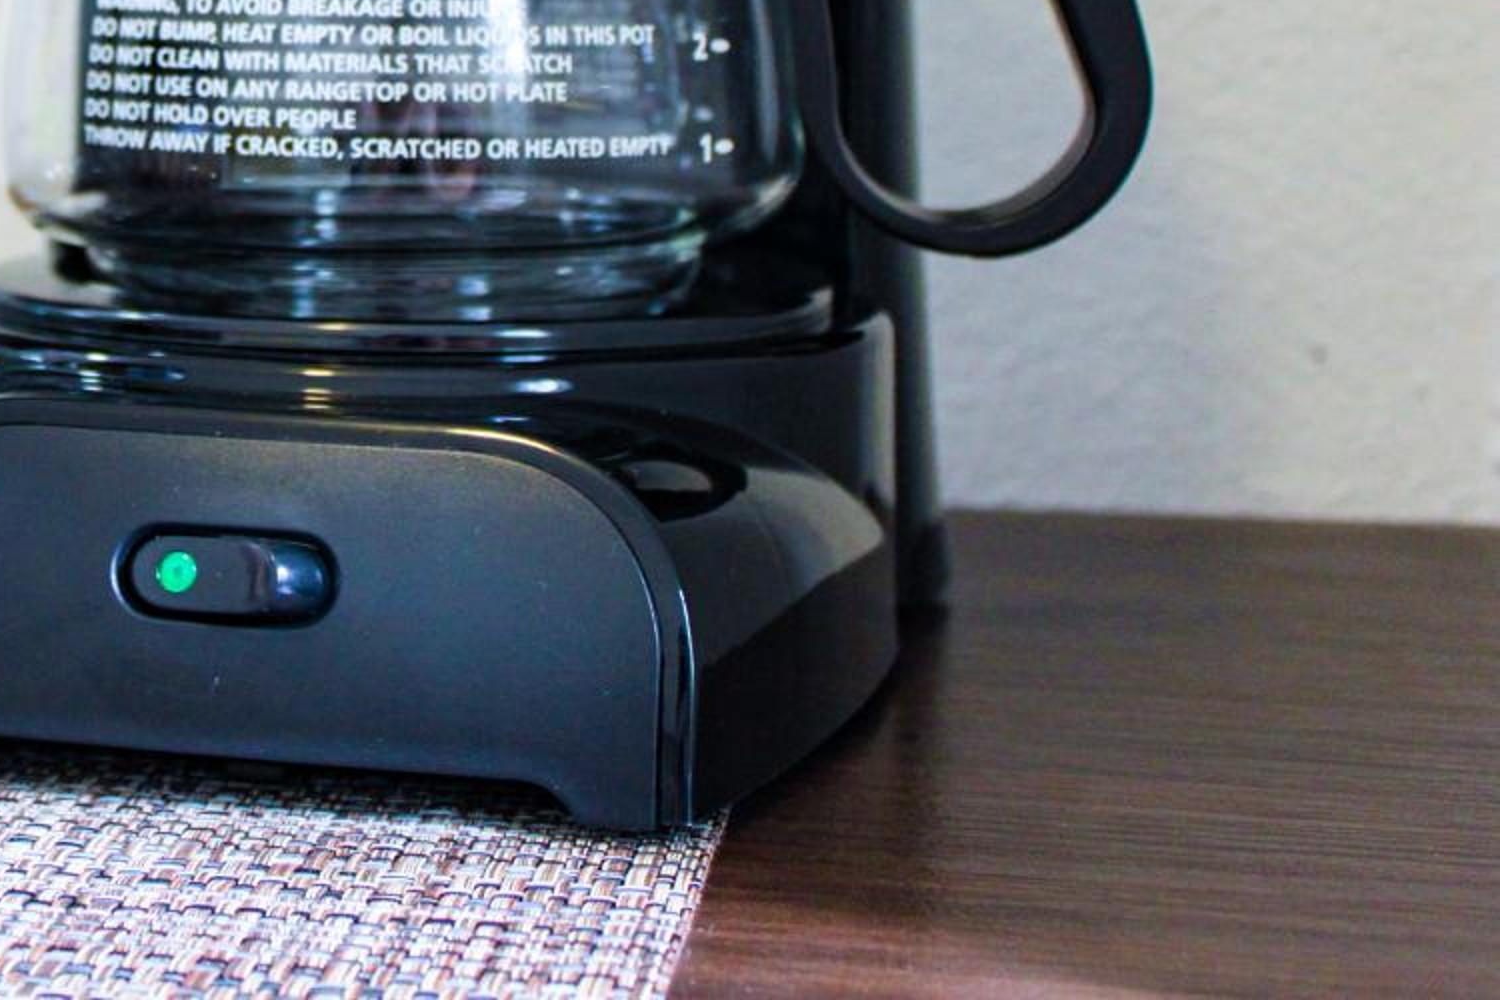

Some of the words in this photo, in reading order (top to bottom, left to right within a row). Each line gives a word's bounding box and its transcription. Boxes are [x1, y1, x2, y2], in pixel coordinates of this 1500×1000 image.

[92, 16, 117, 37] DO
[119, 18, 157, 38] NOT
[222, 22, 277, 43] HEAT
[280, 23, 355, 44] EMPTY
[361, 25, 394, 45] OR
[398, 25, 448, 46] BOIL
[455, 25, 541, 48] LIQUDS
[546, 25, 567, 46] IN
[569, 24, 615, 46] THIS
[619, 23, 655, 45] POT
[692, 31, 709, 62] 2
[89, 43, 114, 64] DO
[116, 45, 154, 65] NOT
[156, 47, 220, 70] CLEAN
[224, 50, 279, 71] WITH
[283, 51, 409, 73] MATERIALS
[414, 52, 470, 74] THAT
[86, 70, 111, 91] DO
[114, 72, 152, 94] NOT
[155, 75, 193, 96] USE
[195, 76, 228, 98] ON
[231, 78, 280, 100] ANY
[284, 80, 409, 102] RANGETOP
[413, 81, 447, 103] OR
[451, 82, 499, 103] HOT
[505, 82, 568, 103] PLATE
[85, 97, 110, 119] DO
[112, 99, 150, 121] NOT
[153, 101, 208, 125] HOLD
[213, 104, 271, 127] OVER
[275, 107, 356, 130] PEOPLE
[148, 128, 210, 151] AWAY
[213, 133, 233, 154] IF
[235, 134, 343, 161] CRACKED,
[350, 137, 481, 160] SCRATCHED
[487, 138, 520, 160] OR
[524, 136, 605, 160] HEATED
[609, 132, 674, 158] EMPTY
[700, 133, 713, 163] 1
